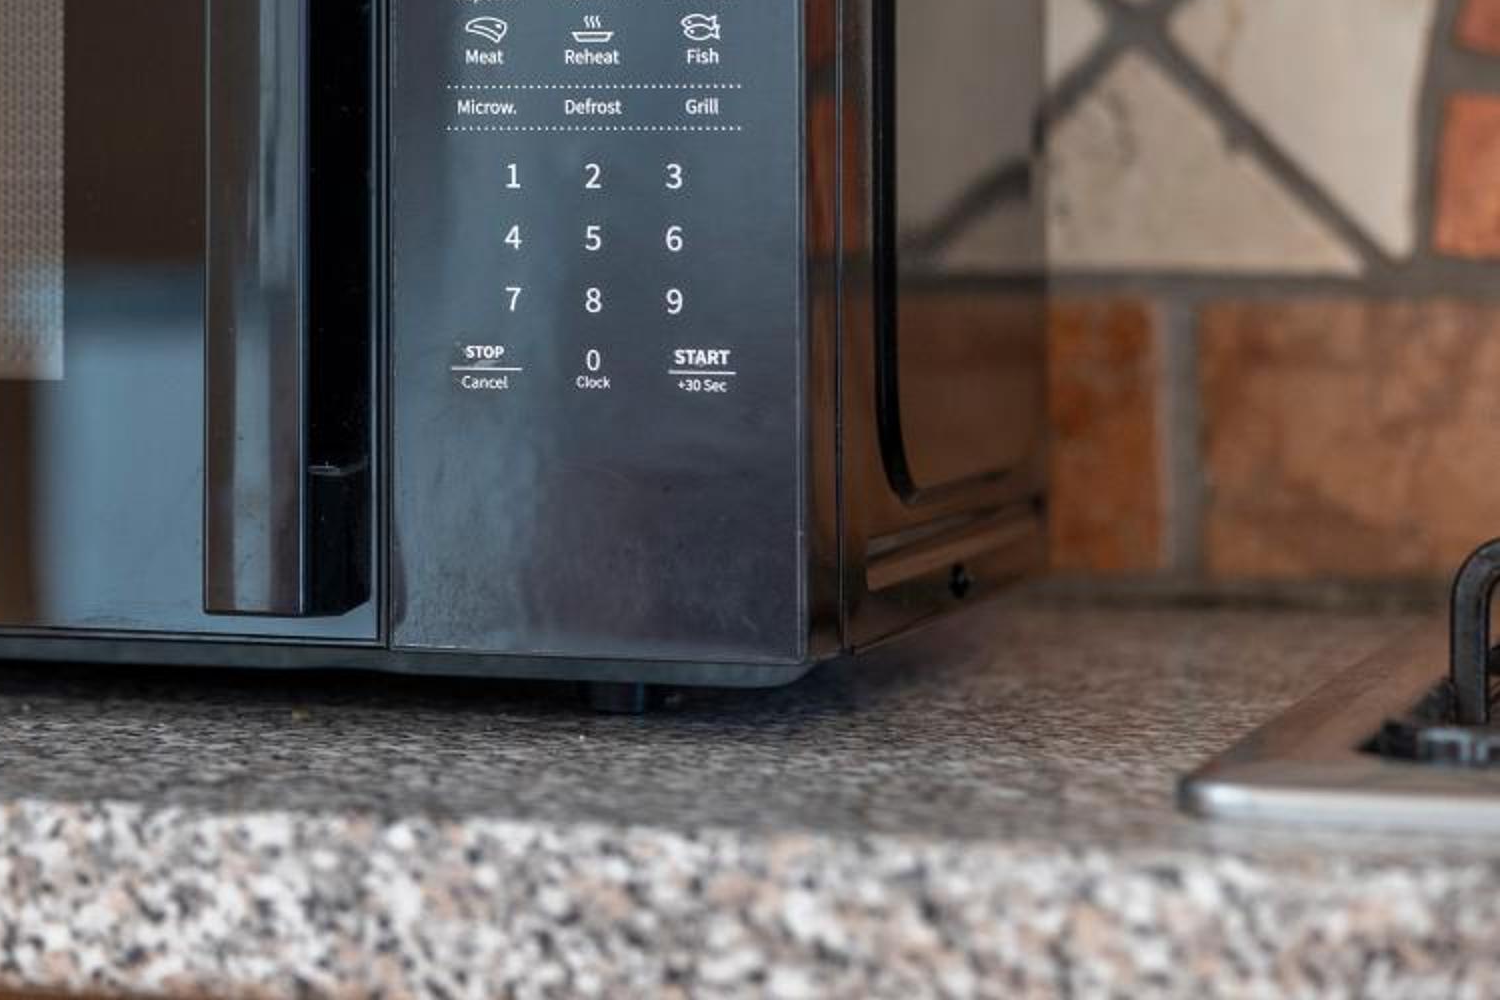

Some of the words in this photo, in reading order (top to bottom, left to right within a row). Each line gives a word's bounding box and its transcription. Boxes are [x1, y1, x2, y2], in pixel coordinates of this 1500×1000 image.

[465, 50, 504, 64] Meat
[564, 50, 620, 64] Reheat
[687, 49, 719, 64] Fish
[457, 99, 517, 115] Microw.
[565, 99, 622, 115] Defrost
[685, 98, 719, 114] Grill
[505, 164, 521, 189] 1
[585, 163, 601, 189] 2
[666, 163, 683, 189] 3
[505, 225, 522, 250] 4
[585, 226, 601, 251] 5
[666, 226, 683, 251] 6
[505, 287, 521, 311] 7
[585, 287, 602, 313] 8
[666, 289, 683, 314] 9
[466, 345, 505, 359] STOP
[675, 349, 730, 365] START
[586, 350, 600, 371] 0
[461, 375, 509, 389] Cancel
[576, 375, 611, 389] Clock
[677, 379, 701, 391] +30
[703, 379, 727, 392] Sec
